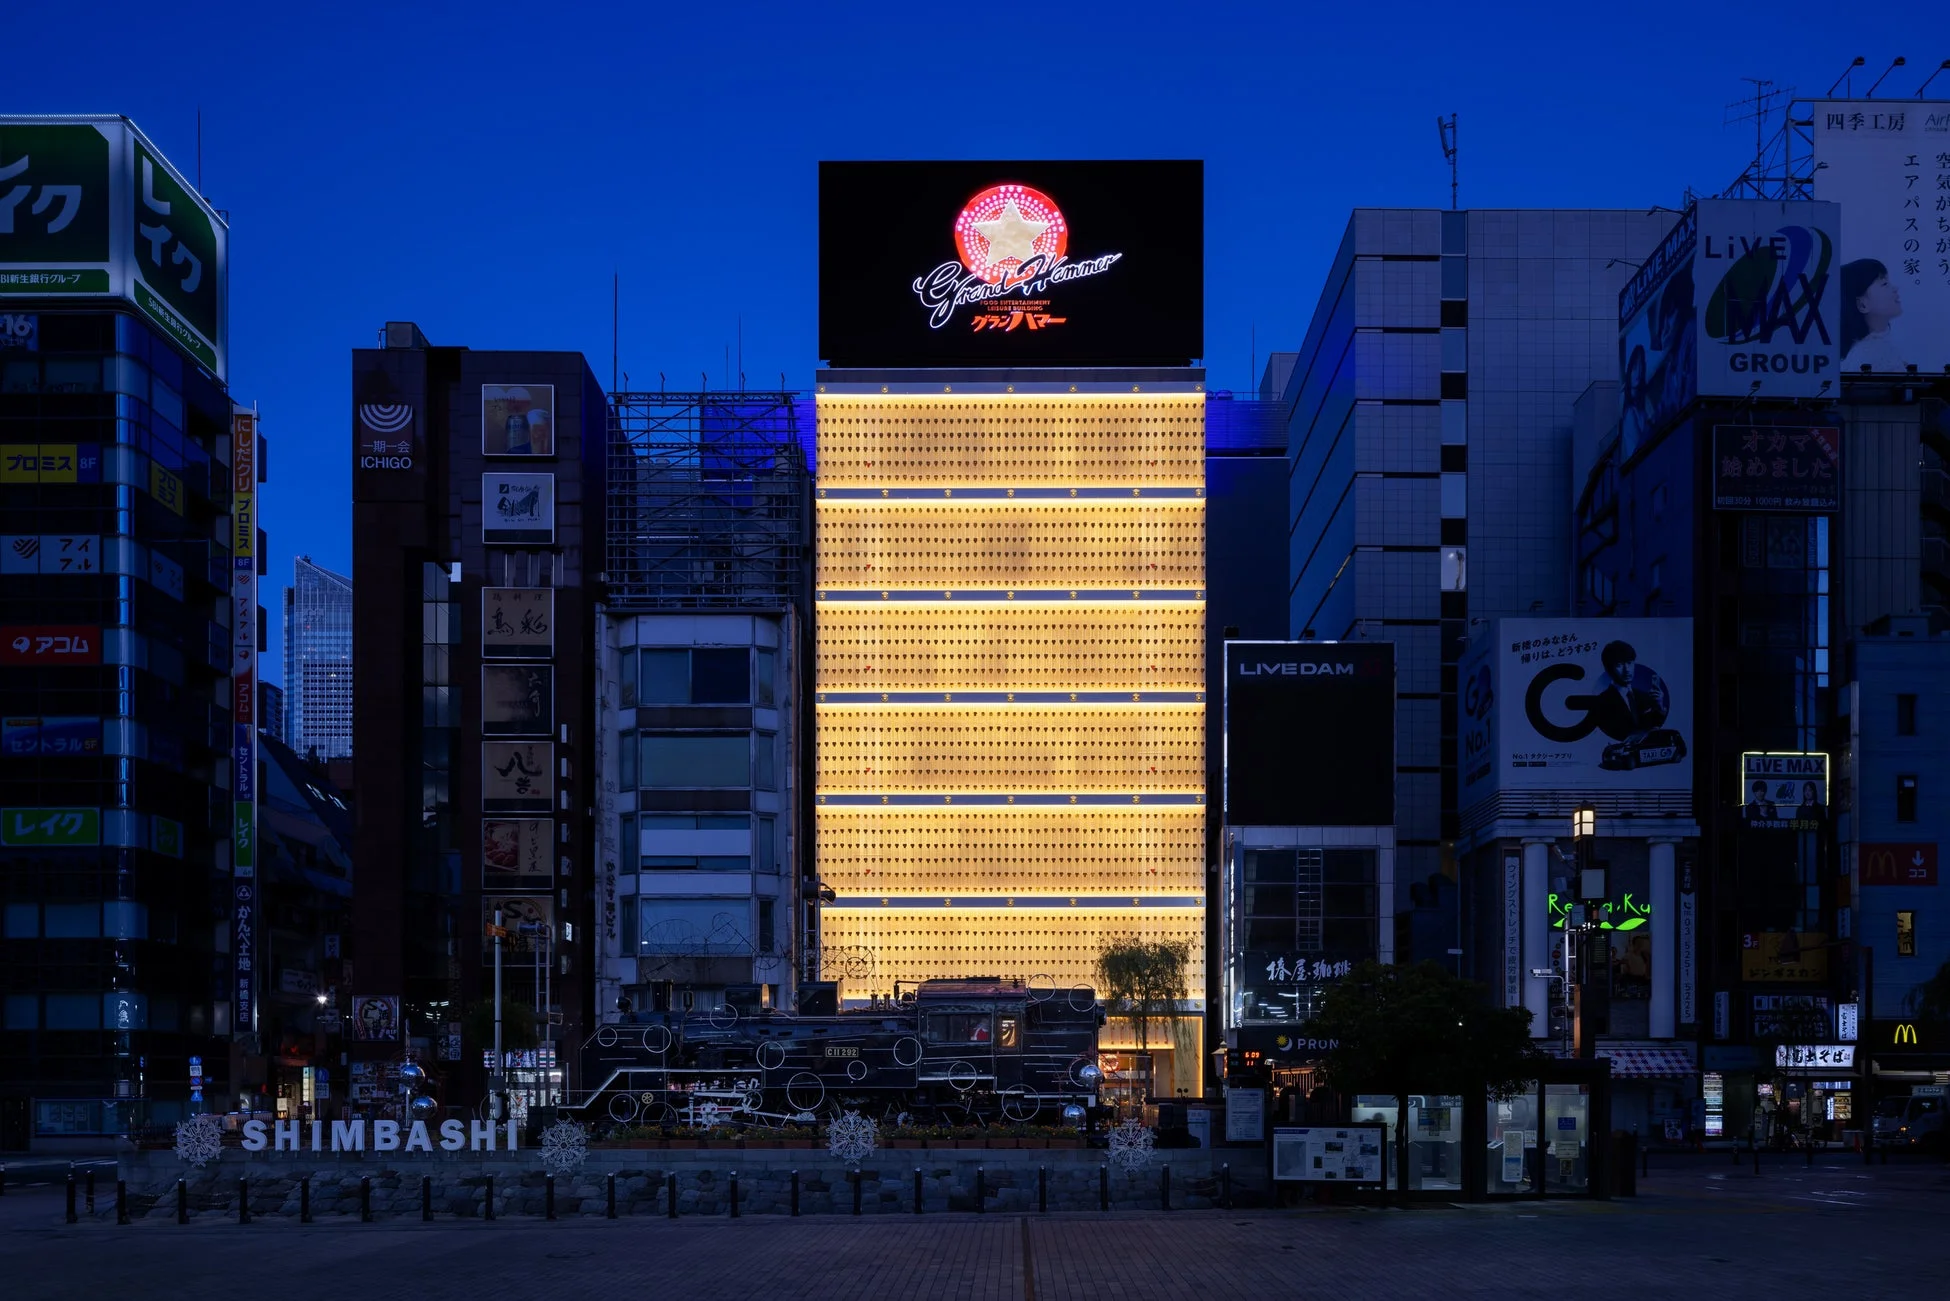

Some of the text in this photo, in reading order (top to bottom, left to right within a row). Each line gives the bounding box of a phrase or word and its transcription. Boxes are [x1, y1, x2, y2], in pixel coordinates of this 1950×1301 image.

[1827, 112, 1905, 131] 四季工房
[1904, 154, 1920, 286] エアパスの家。
[912, 252, 1123, 329] Grand Hammer
[1727, 273, 1832, 345] MAX
[971, 311, 1067, 332] グランハマー
[1729, 353, 1830, 374] GROUP
[361, 440, 412, 453] 一期一会
[1741, 429, 1811, 452] オカマ
[7, 455, 97, 471] プロミス 8F
[361, 456, 412, 469] ICHIGO
[1721, 456, 1832, 478] 始めました
[238, 499, 251, 550] プロミス
[237, 558, 250, 567] 8F
[239, 598, 248, 641] アイフル
[36, 637, 89, 654] アコム
[1512, 633, 1578, 652] 新橋のみなさん
[1240, 663, 1354, 675] LIVEDAM
[238, 683, 249, 713] アコム
[1525, 663, 1670, 742] GO
[11, 738, 97, 753] セントラル 5F
[239, 746, 249, 792] セントラル
[1747, 759, 1824, 772] LiVE MAX
[15, 813, 84, 836] レイク
[238, 818, 248, 849] レイク
[1908, 869, 1927, 878] ココ
[237, 905, 252, 972] かんべ土地
[1266, 956, 1352, 981] 椿屋珈琲
[1749, 967, 1820, 978] ジンギスカン
[239, 978, 249, 1023] 新橋支店
[842, 1048, 857, 1056] 292
[241, 1119, 518, 1152] SHIMBASHI
